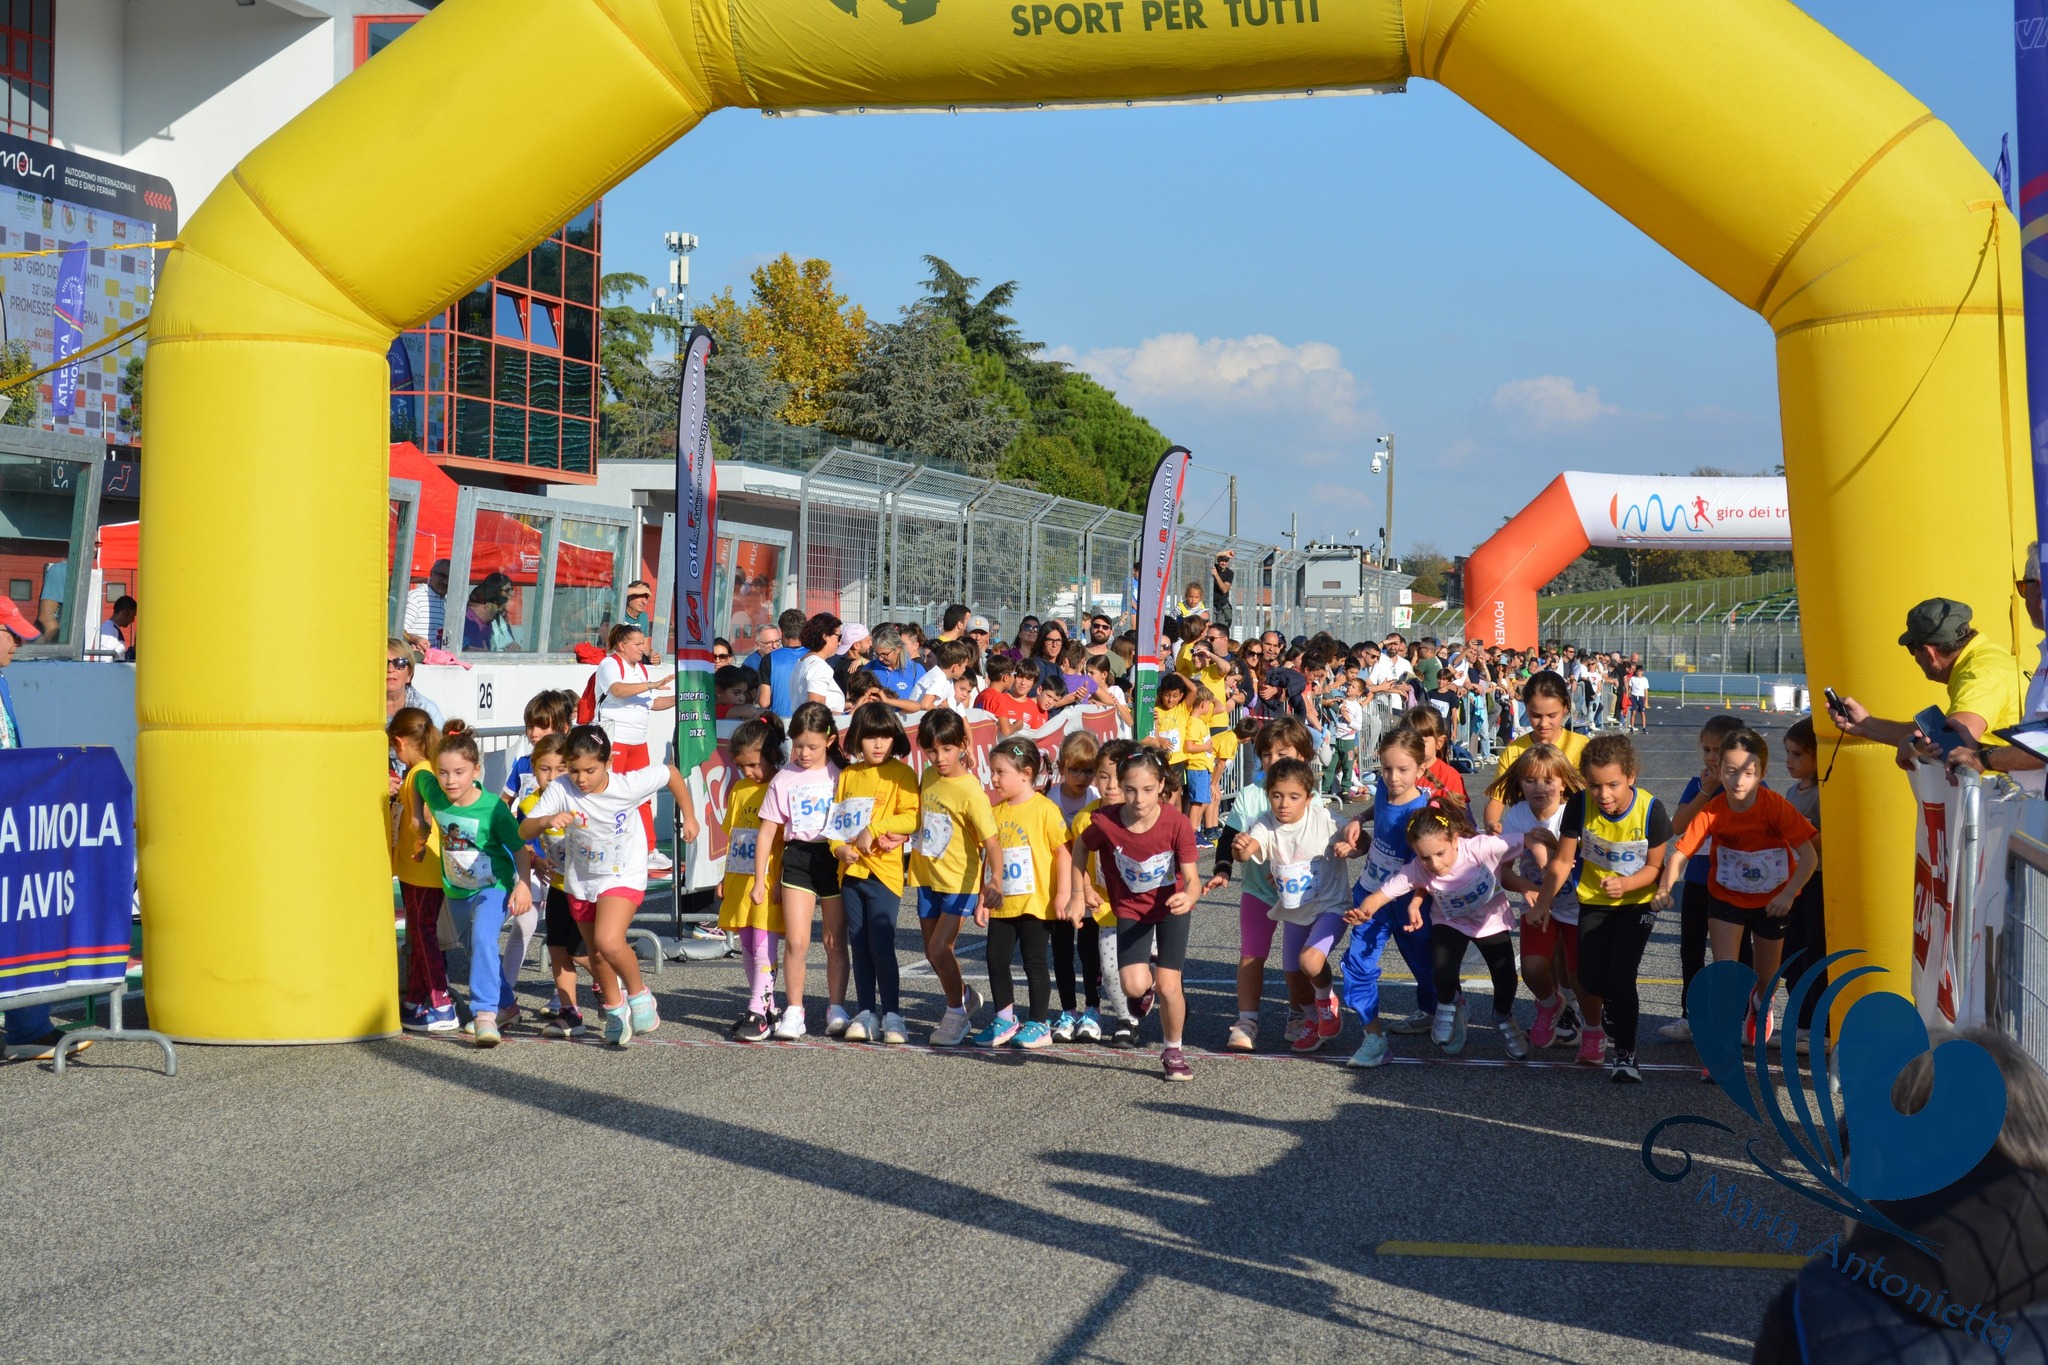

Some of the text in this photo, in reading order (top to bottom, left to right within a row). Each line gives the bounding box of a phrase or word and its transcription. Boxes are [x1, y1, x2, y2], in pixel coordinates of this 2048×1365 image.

[1011, 0, 1321, 37] SPORT PER TUTTI
[65, 167, 136, 193] AUTODROMO INTERNAZIONALE
[65, 177, 78, 188] ENZO
[83, 182, 96, 192] DINO
[97, 185, 116, 198] FERRARI
[27, 260, 46, 277] GIRO
[10, 296, 51, 317] PROMESSE
[58, 334, 70, 407] ATLECA
[1158, 463, 1173, 543] BERNABEI
[1716, 506, 1745, 522] giro
[1748, 506, 1771, 519] dei
[1494, 600, 1505, 646] POWER
[479, 683, 493, 709] 26
[29, 802, 122, 851] IMOLA
[834, 810, 861, 830] 561
[580, 847, 604, 861] 251
[732, 842, 756, 859] 548
[1593, 844, 1635, 862] 566
[1125, 865, 1166, 882] 555
[1742, 867, 1761, 879] 28
[16, 869, 75, 921] AVIS
[1275, 875, 1312, 894] 562
[1450, 881, 1489, 908] 558
